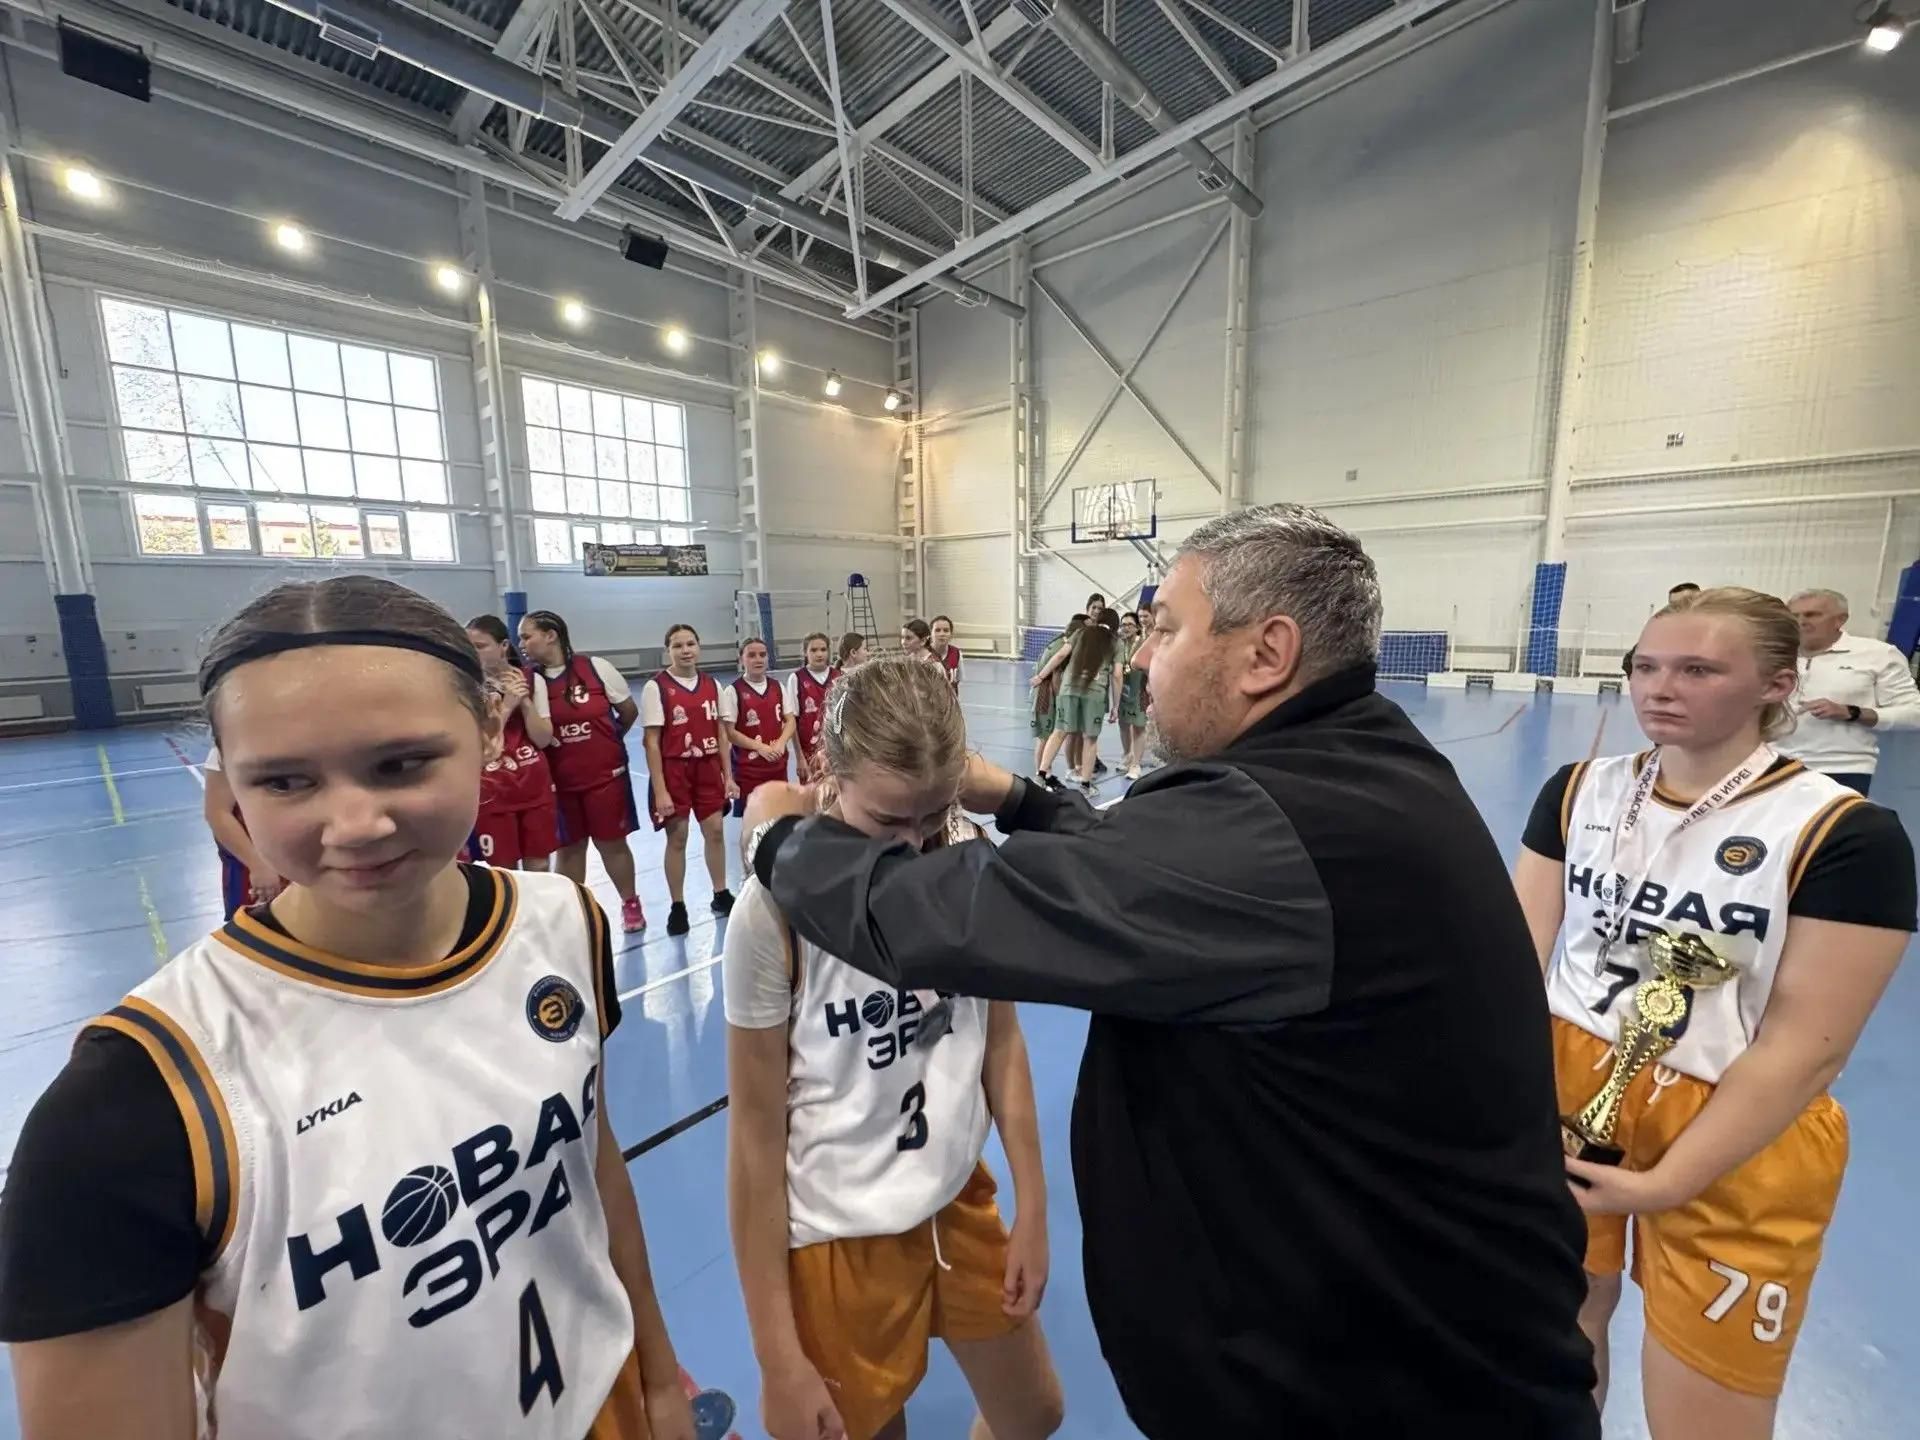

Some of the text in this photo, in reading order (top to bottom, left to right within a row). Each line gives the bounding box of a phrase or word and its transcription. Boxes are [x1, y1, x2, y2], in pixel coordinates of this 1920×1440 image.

[560, 722, 592, 736] КЭС
[702, 700, 718, 720] 14
[1711, 793, 1722, 802] В
[1720, 768, 1752, 795] ИГРЕ!
[479, 834, 494, 857] 9
[297, 1091, 363, 1135] LYKIA
[897, 1080, 928, 1151] 3
[1701, 1259, 1788, 1342] 79
[519, 1278, 565, 1417] 4
